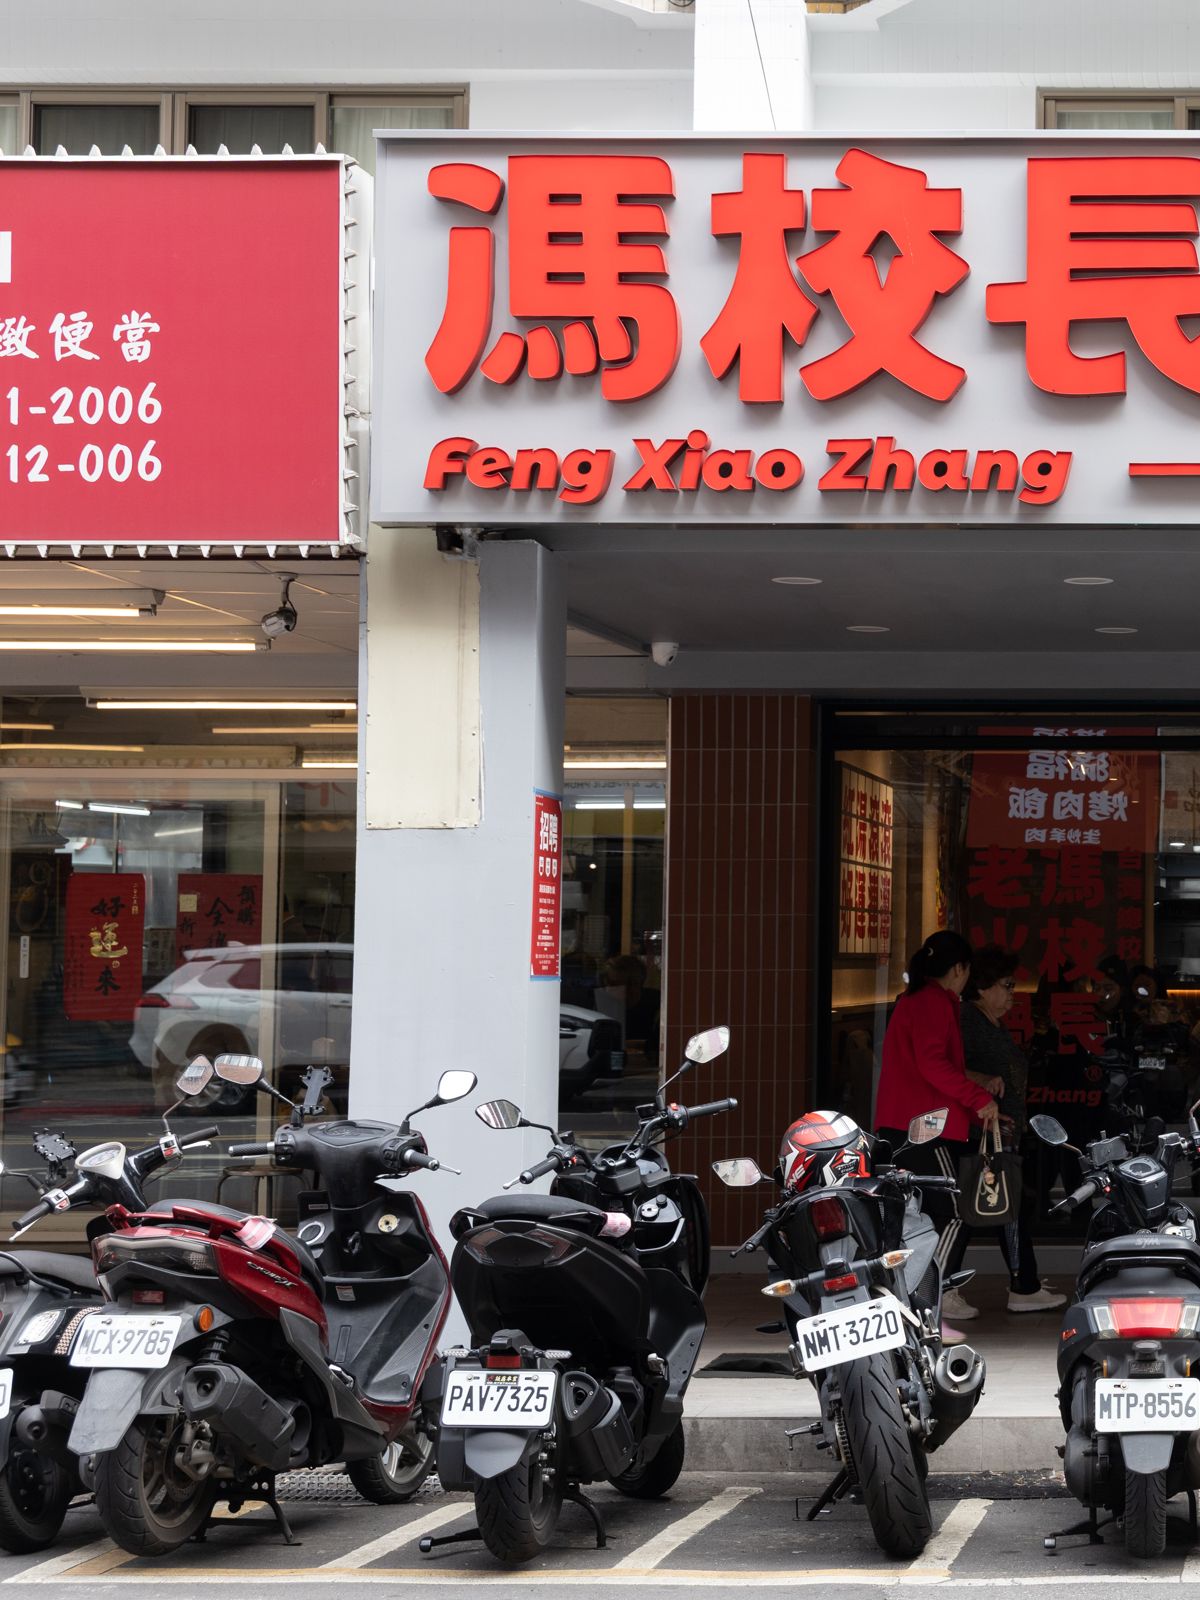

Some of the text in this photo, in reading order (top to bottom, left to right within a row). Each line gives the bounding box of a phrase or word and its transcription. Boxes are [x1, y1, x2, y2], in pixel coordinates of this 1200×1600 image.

[6, 382, 162, 425] 1-2006
[6, 439, 162, 483] 12-006
[423, 429, 1073, 505] Feng Xiao Zhang
[1039, 845, 1106, 1056] 馮校長
[1027, 1085, 1103, 1107] Zhang
